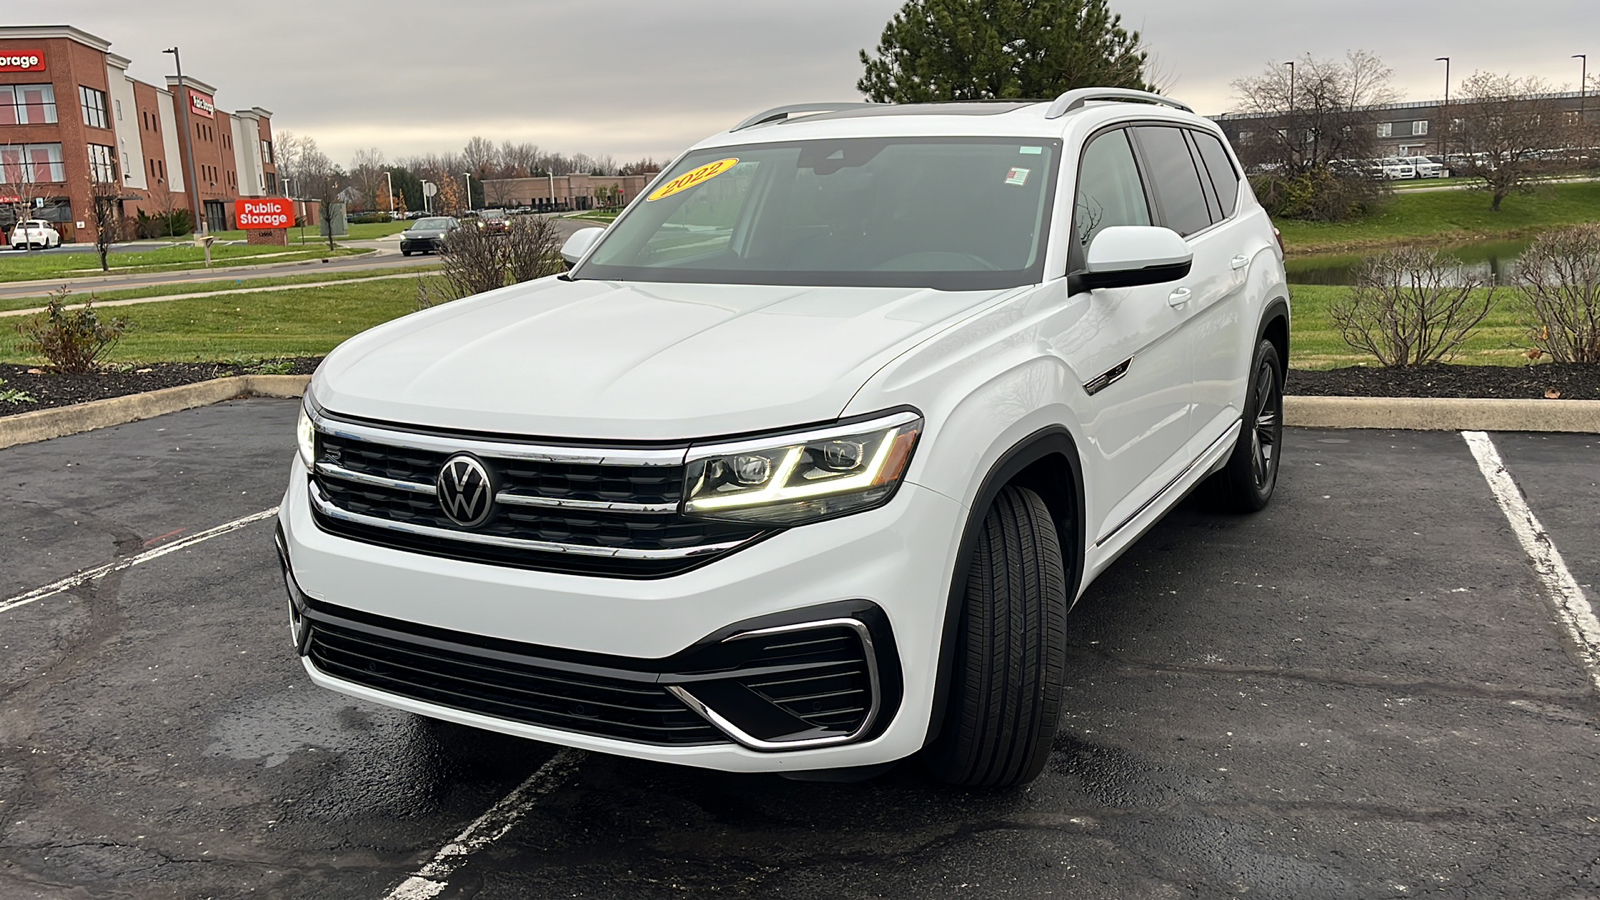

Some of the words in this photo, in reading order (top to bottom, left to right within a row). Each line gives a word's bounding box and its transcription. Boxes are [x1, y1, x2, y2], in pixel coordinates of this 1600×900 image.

[660, 162, 724, 197] 2022
[244, 202, 282, 214] Public
[240, 213, 288, 226] Storage
